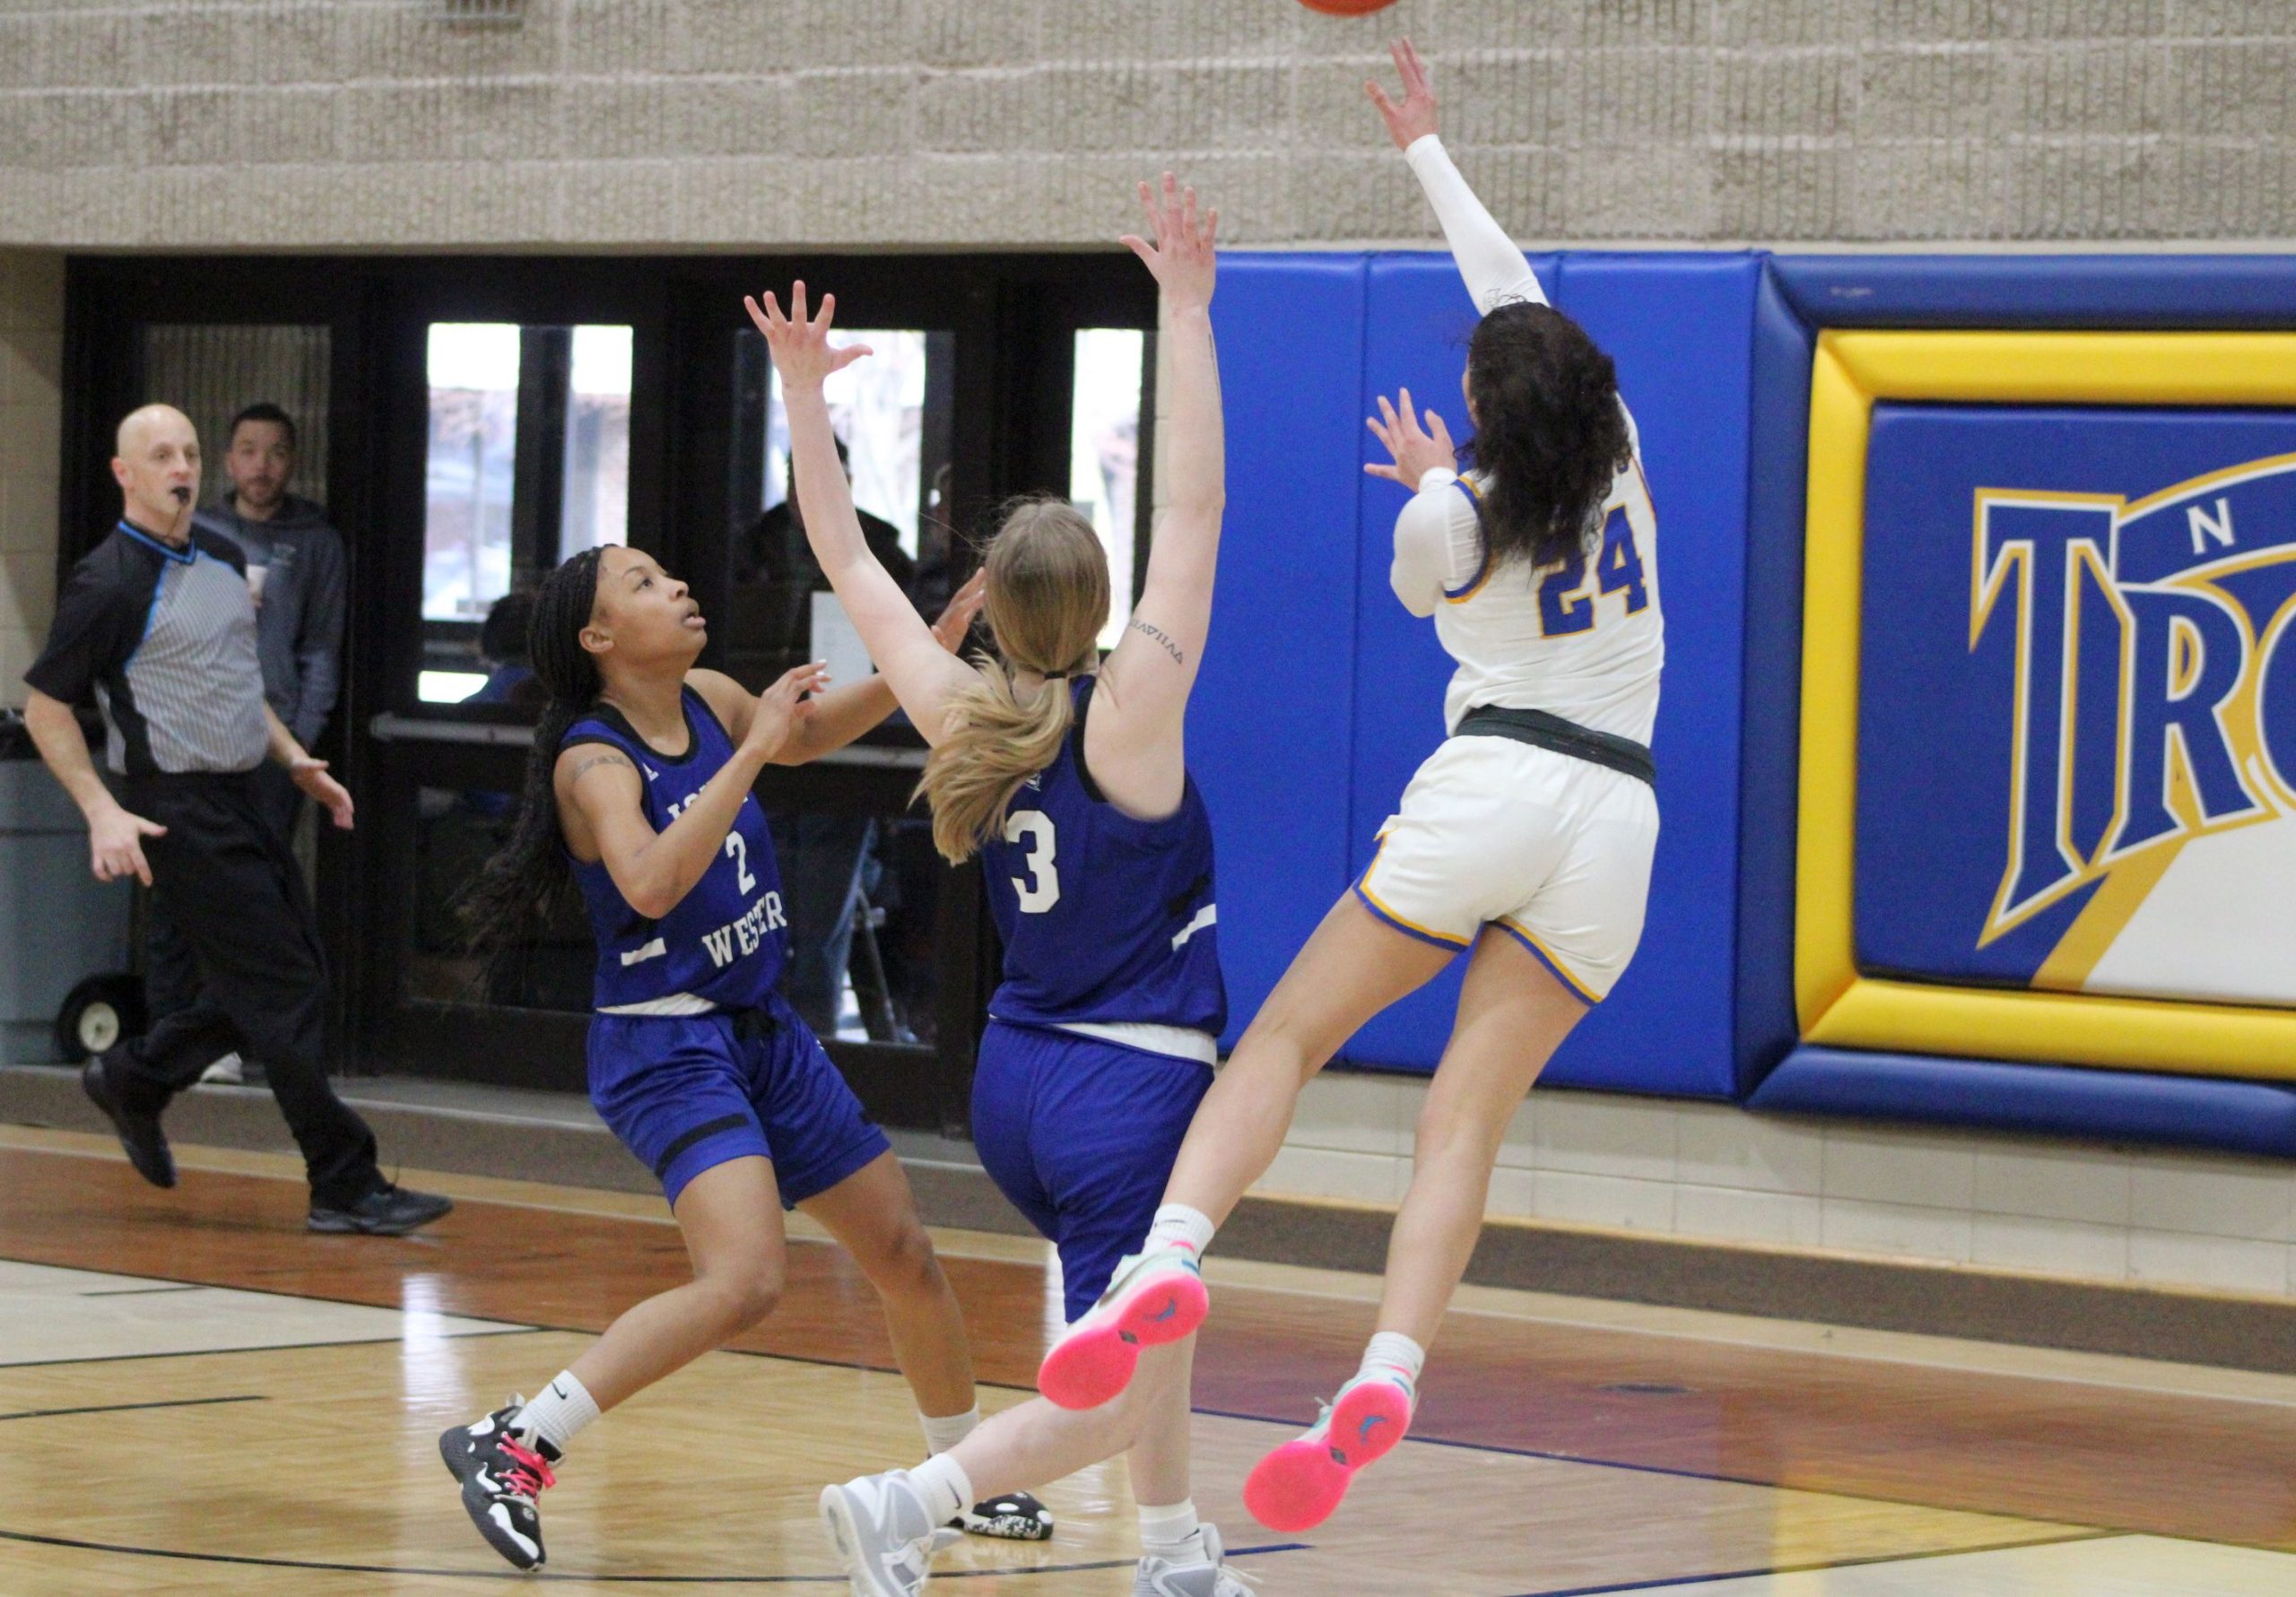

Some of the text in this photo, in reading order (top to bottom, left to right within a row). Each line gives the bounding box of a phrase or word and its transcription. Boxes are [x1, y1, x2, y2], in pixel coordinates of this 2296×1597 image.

[1532, 502, 1648, 638] 24
[1970, 487, 2296, 950] TR
[726, 830, 756, 895] 2
[1006, 810, 1060, 913] 3
